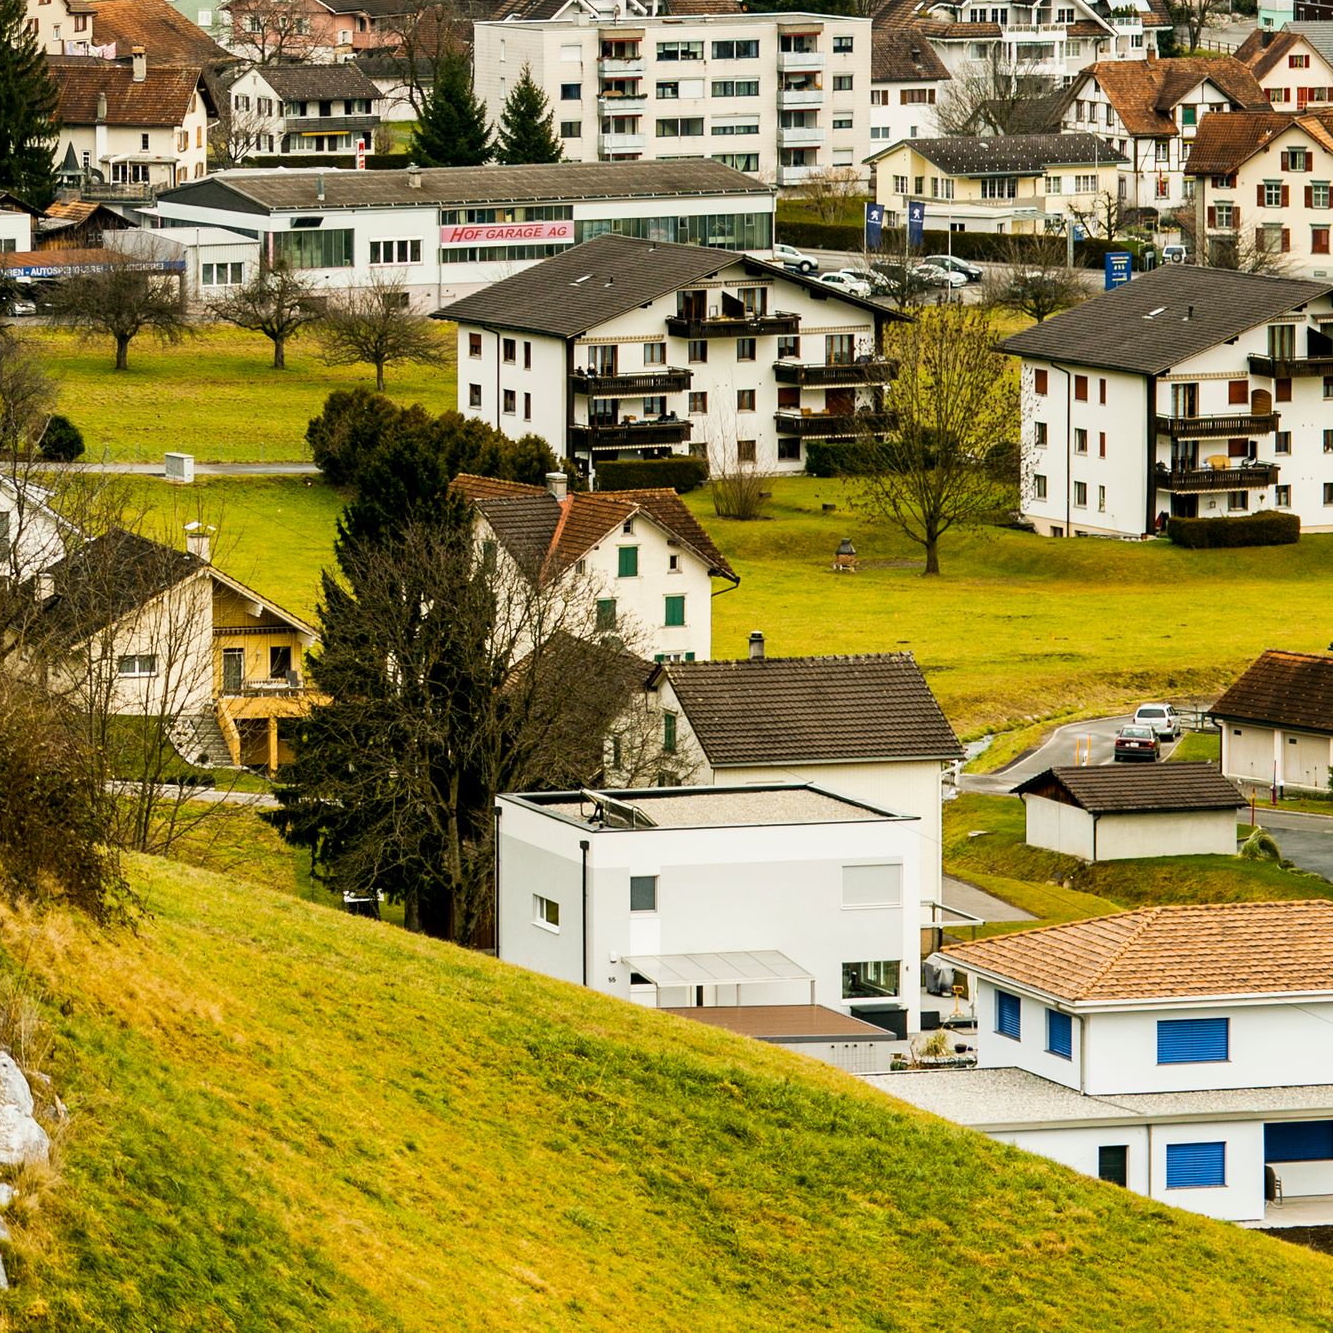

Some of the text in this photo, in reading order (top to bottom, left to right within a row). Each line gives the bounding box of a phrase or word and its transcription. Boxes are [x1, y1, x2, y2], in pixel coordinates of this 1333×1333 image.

[449, 226, 567, 242] HOF GARAGE AG
